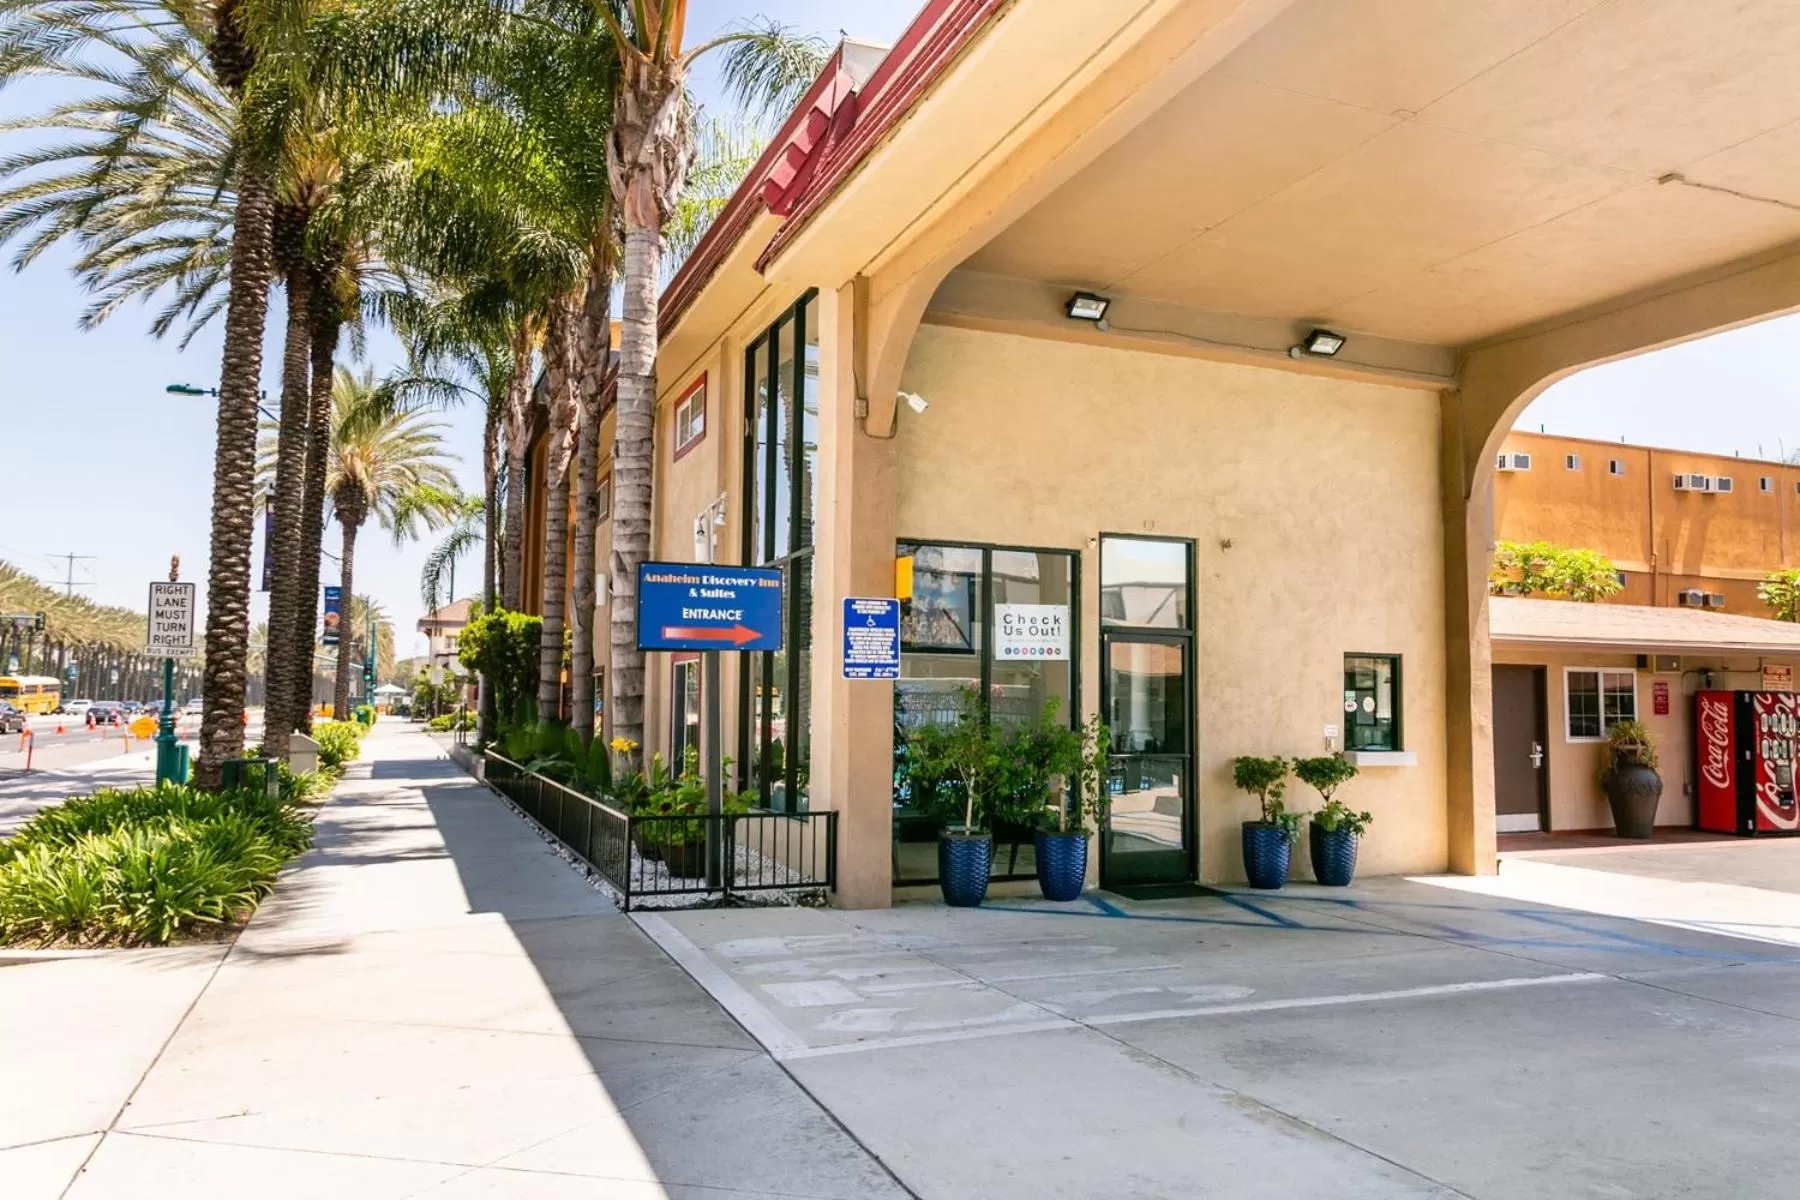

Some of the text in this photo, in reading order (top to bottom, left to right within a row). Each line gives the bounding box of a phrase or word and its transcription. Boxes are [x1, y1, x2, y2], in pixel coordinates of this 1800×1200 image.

[644, 573, 779, 587] Anaheim Discovery Inn
[155, 585, 188, 595] RIGHT
[688, 588, 736, 599] & Suites
[156, 598, 188, 607] LANE
[155, 610, 187, 620] MUST
[682, 607, 742, 620] ENTRANCE
[1003, 613, 1061, 625] Check
[156, 622, 187, 632] TURN
[1003, 625, 1061, 636] Us Out!
[153, 635, 187, 644] RIGHT
